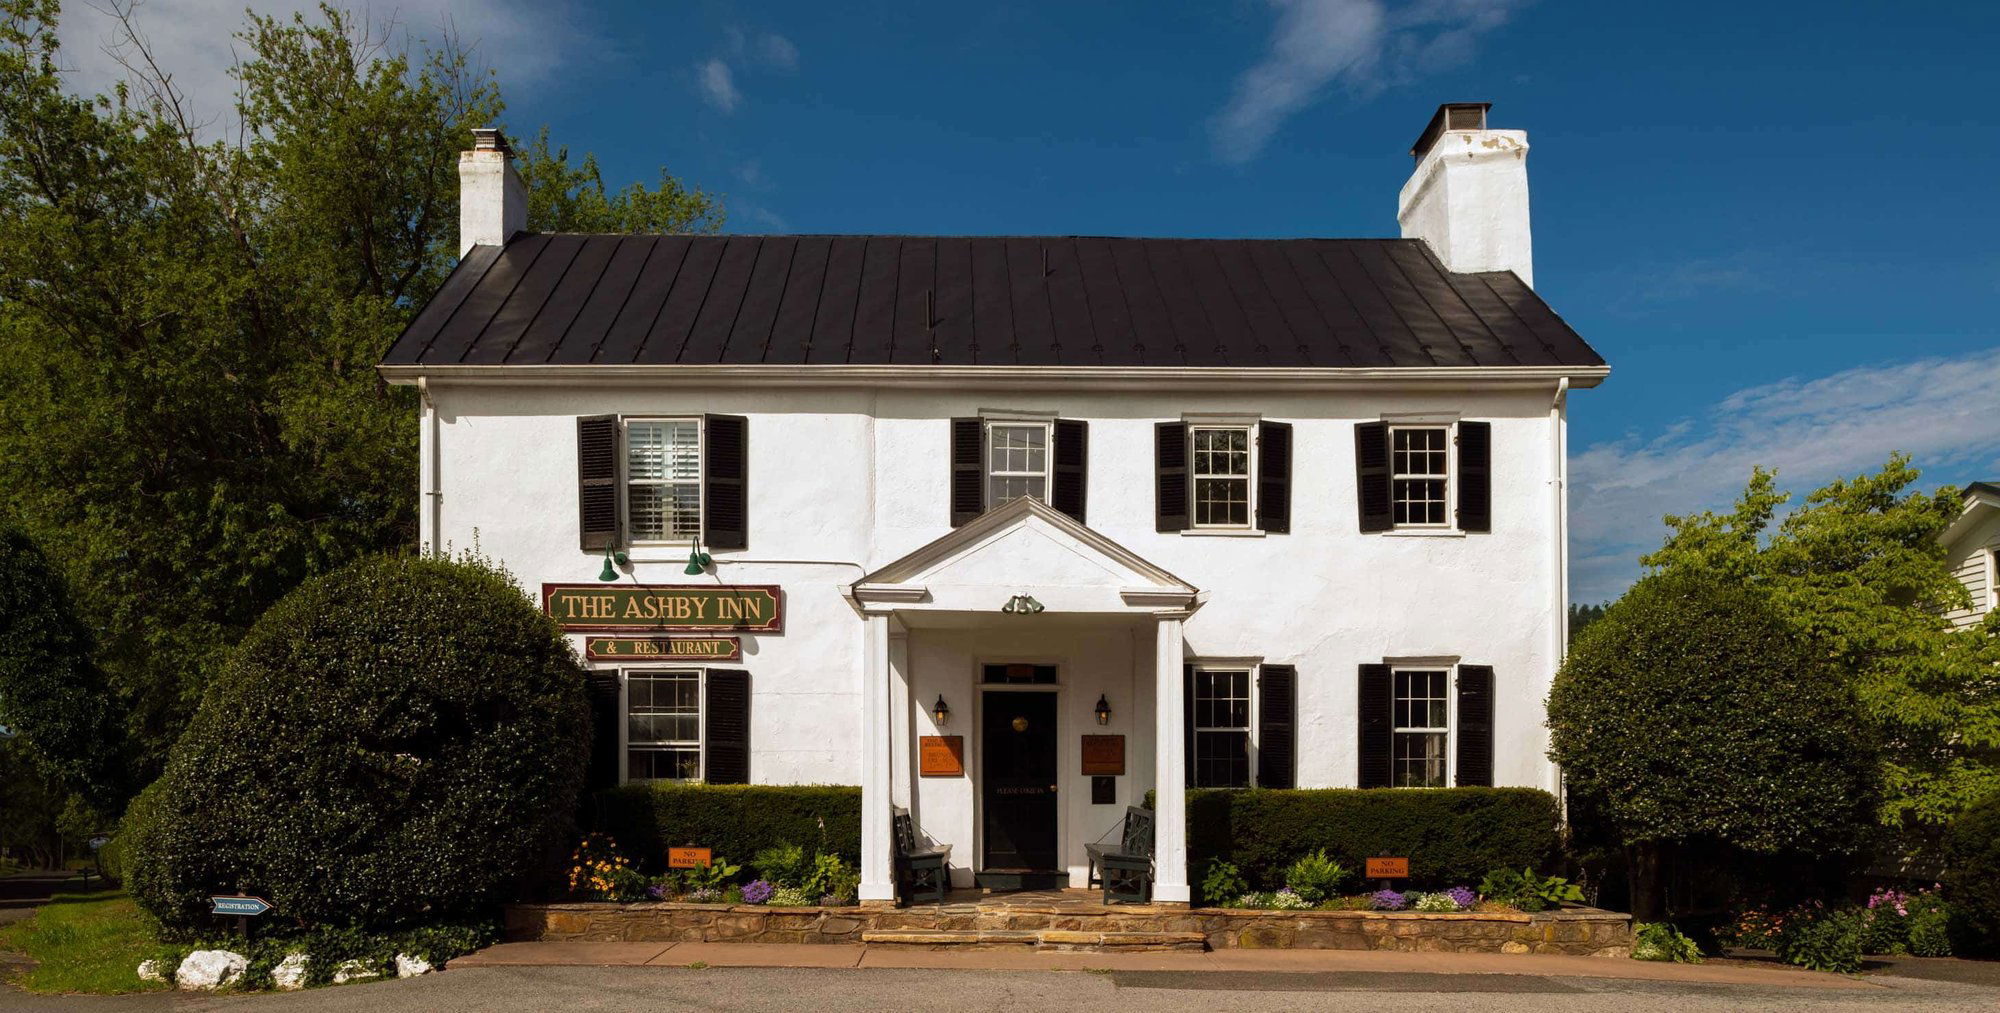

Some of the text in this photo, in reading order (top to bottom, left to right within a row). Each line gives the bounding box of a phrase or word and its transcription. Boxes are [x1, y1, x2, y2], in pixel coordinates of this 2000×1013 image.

[561, 596, 761, 619] THE ASHBY INN
[607, 641, 720, 654] & RESTAURANT
[217, 902, 260, 910] REGISTRATION
